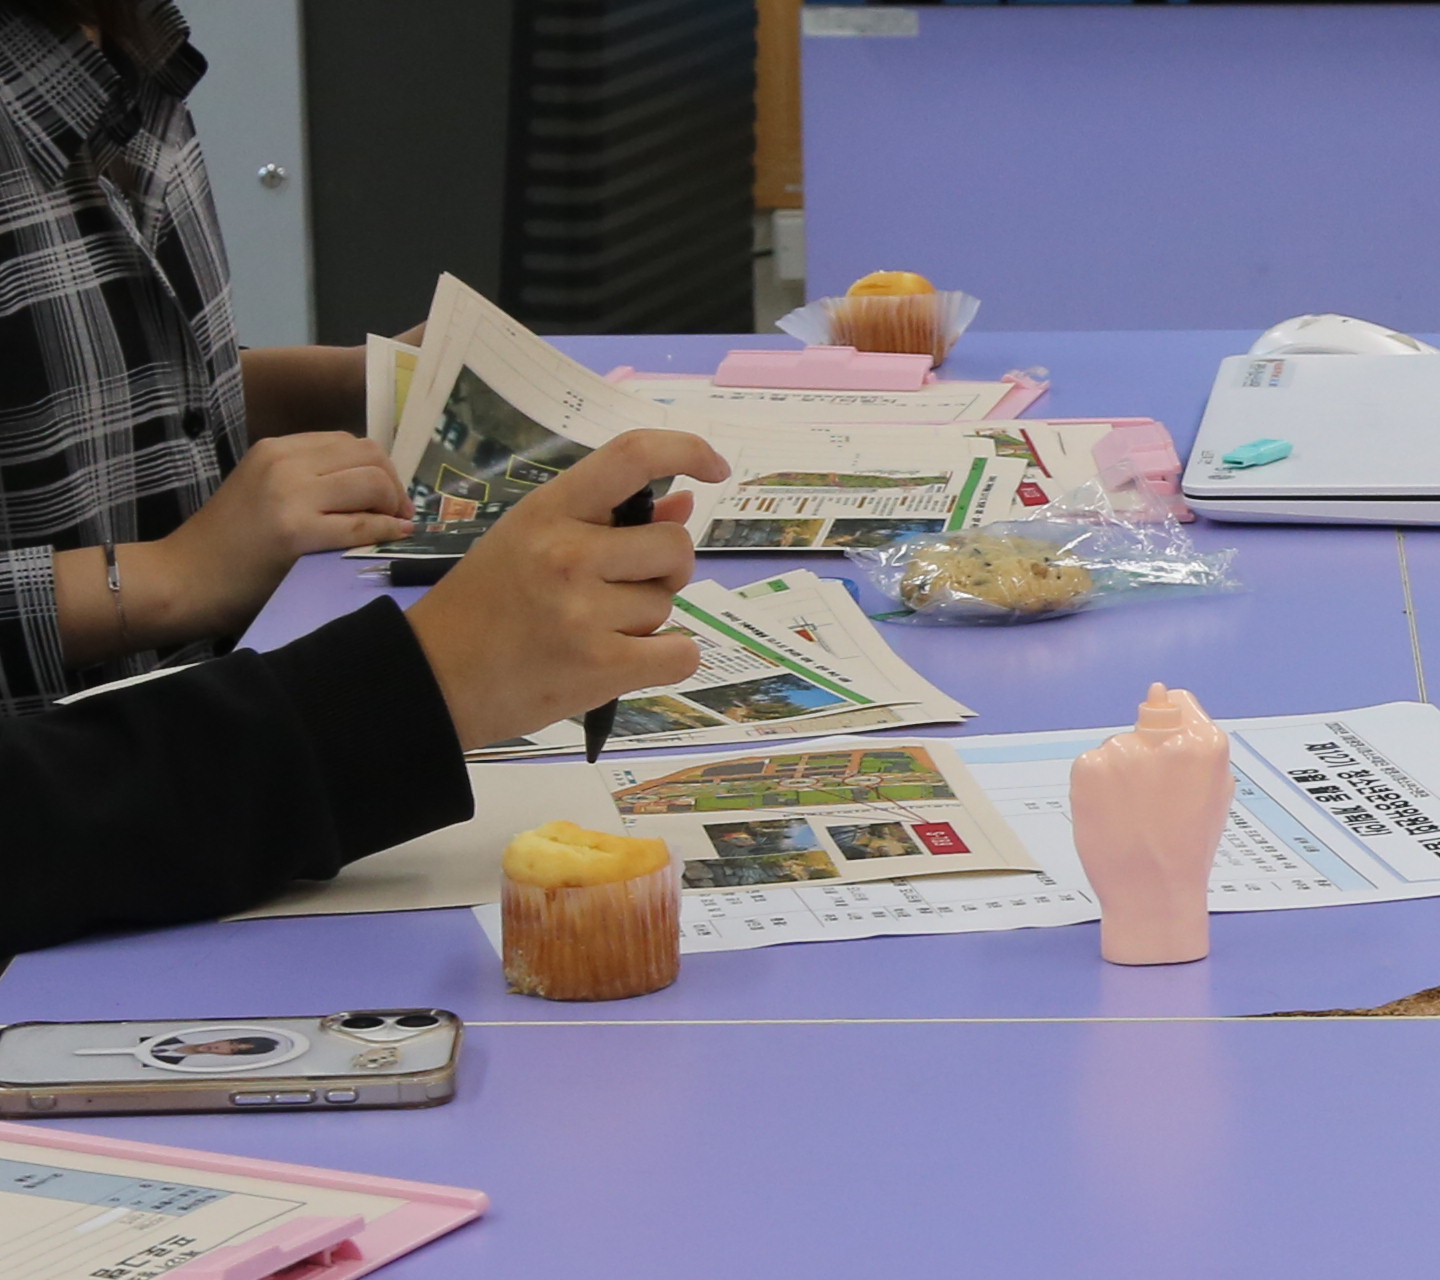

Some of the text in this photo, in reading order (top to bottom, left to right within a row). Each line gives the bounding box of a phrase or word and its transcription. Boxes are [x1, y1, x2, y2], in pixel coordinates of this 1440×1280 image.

[1304, 741, 1360, 768] 제12기
[1305, 784, 1353, 803] 활동
[89, 1234, 198, 1280] 프로그램
